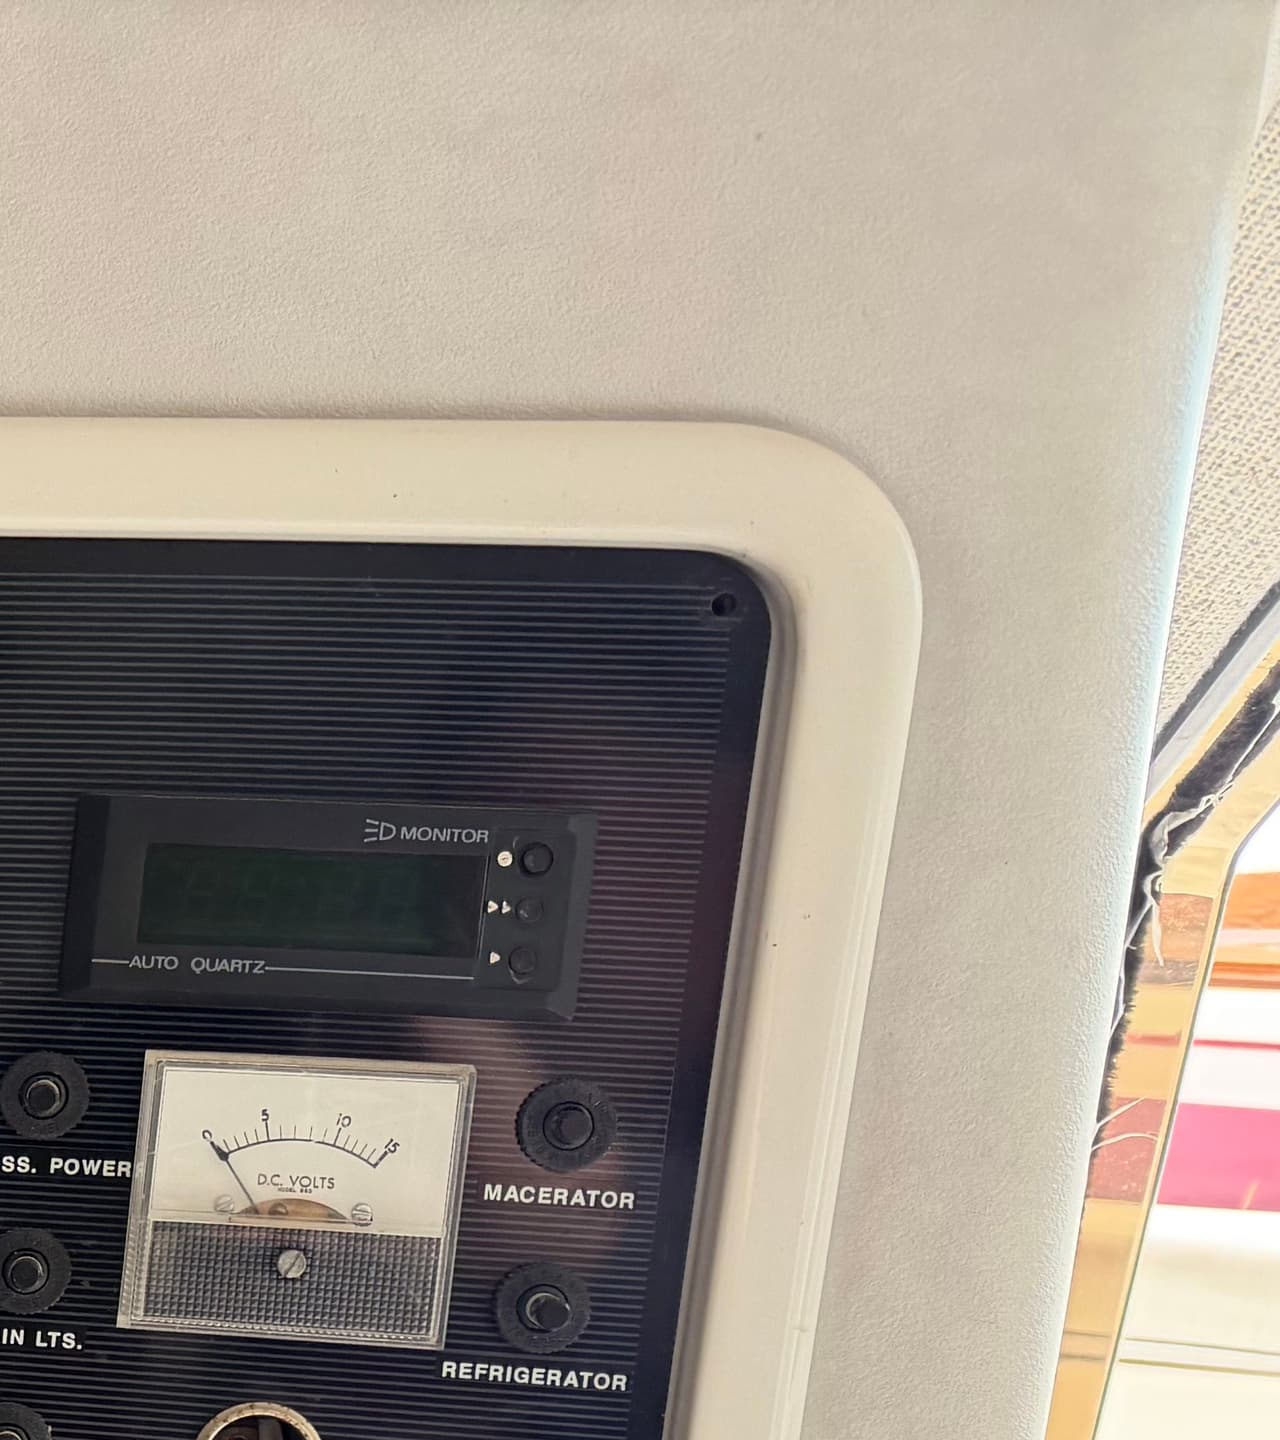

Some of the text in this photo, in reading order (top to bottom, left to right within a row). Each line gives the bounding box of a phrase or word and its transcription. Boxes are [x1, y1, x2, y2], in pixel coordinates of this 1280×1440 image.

[400, 825, 490, 845] MONITOR
[128, 955, 266, 975] AUTO QUARTZ
[261, 1109, 270, 1122] 5
[336, 1113, 353, 1128] 10
[202, 1129, 213, 1141] 0
[384, 1138, 401, 1155] 15
[49, 1157, 133, 1178] POWER
[257, 1173, 335, 1189] D.C. VOLTS
[483, 1183, 635, 1210] MACERATOR
[35, 1331, 83, 1350] LTS.
[441, 1361, 628, 1391] REFRIGERATOR
